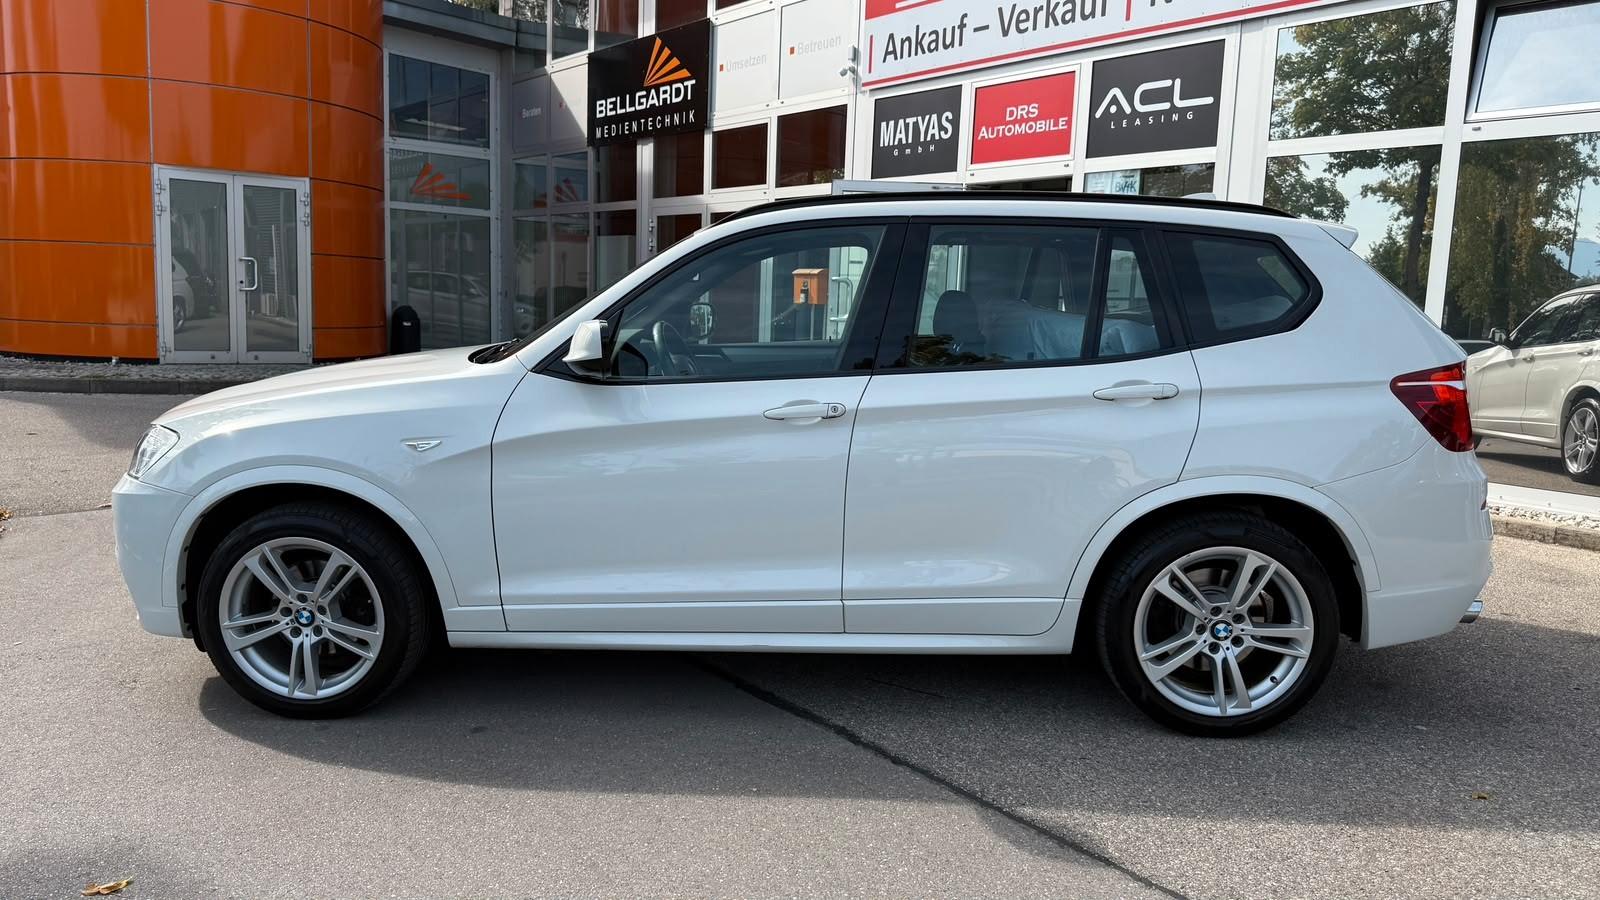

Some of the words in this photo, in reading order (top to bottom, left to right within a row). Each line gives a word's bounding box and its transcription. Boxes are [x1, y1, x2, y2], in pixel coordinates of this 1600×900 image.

[882, 12, 968, 63] Ankauf
[596, 79, 696, 119] BELLGARDT
[1005, 103, 1039, 122] DRS
[1095, 78, 1214, 119] ACL
[595, 109, 696, 139] MEDIENTECHNIK
[879, 111, 953, 147] MATYAS
[1110, 111, 1194, 129] LEASING
